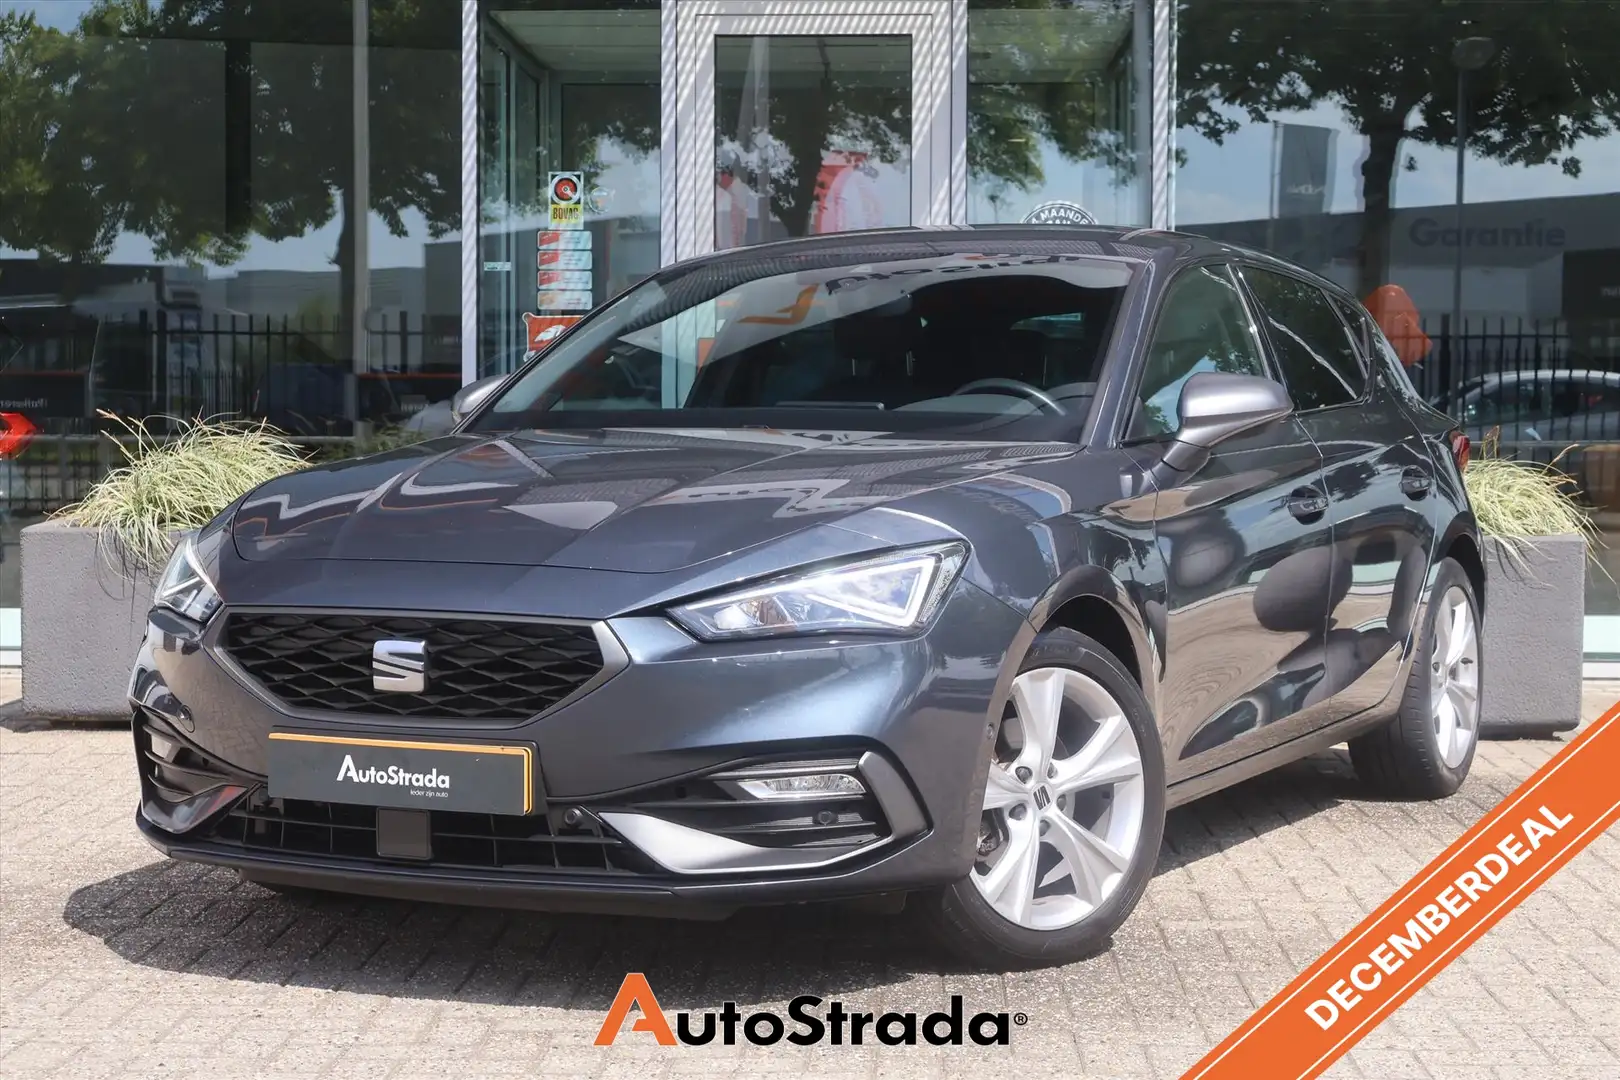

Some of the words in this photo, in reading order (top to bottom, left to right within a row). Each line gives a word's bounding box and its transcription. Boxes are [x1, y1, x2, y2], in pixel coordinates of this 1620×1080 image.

[553, 207, 579, 220] BOVAG
[1409, 217, 1565, 247] Garantie
[336, 754, 450, 789] AutoStrada
[435, 790, 448, 798] auto
